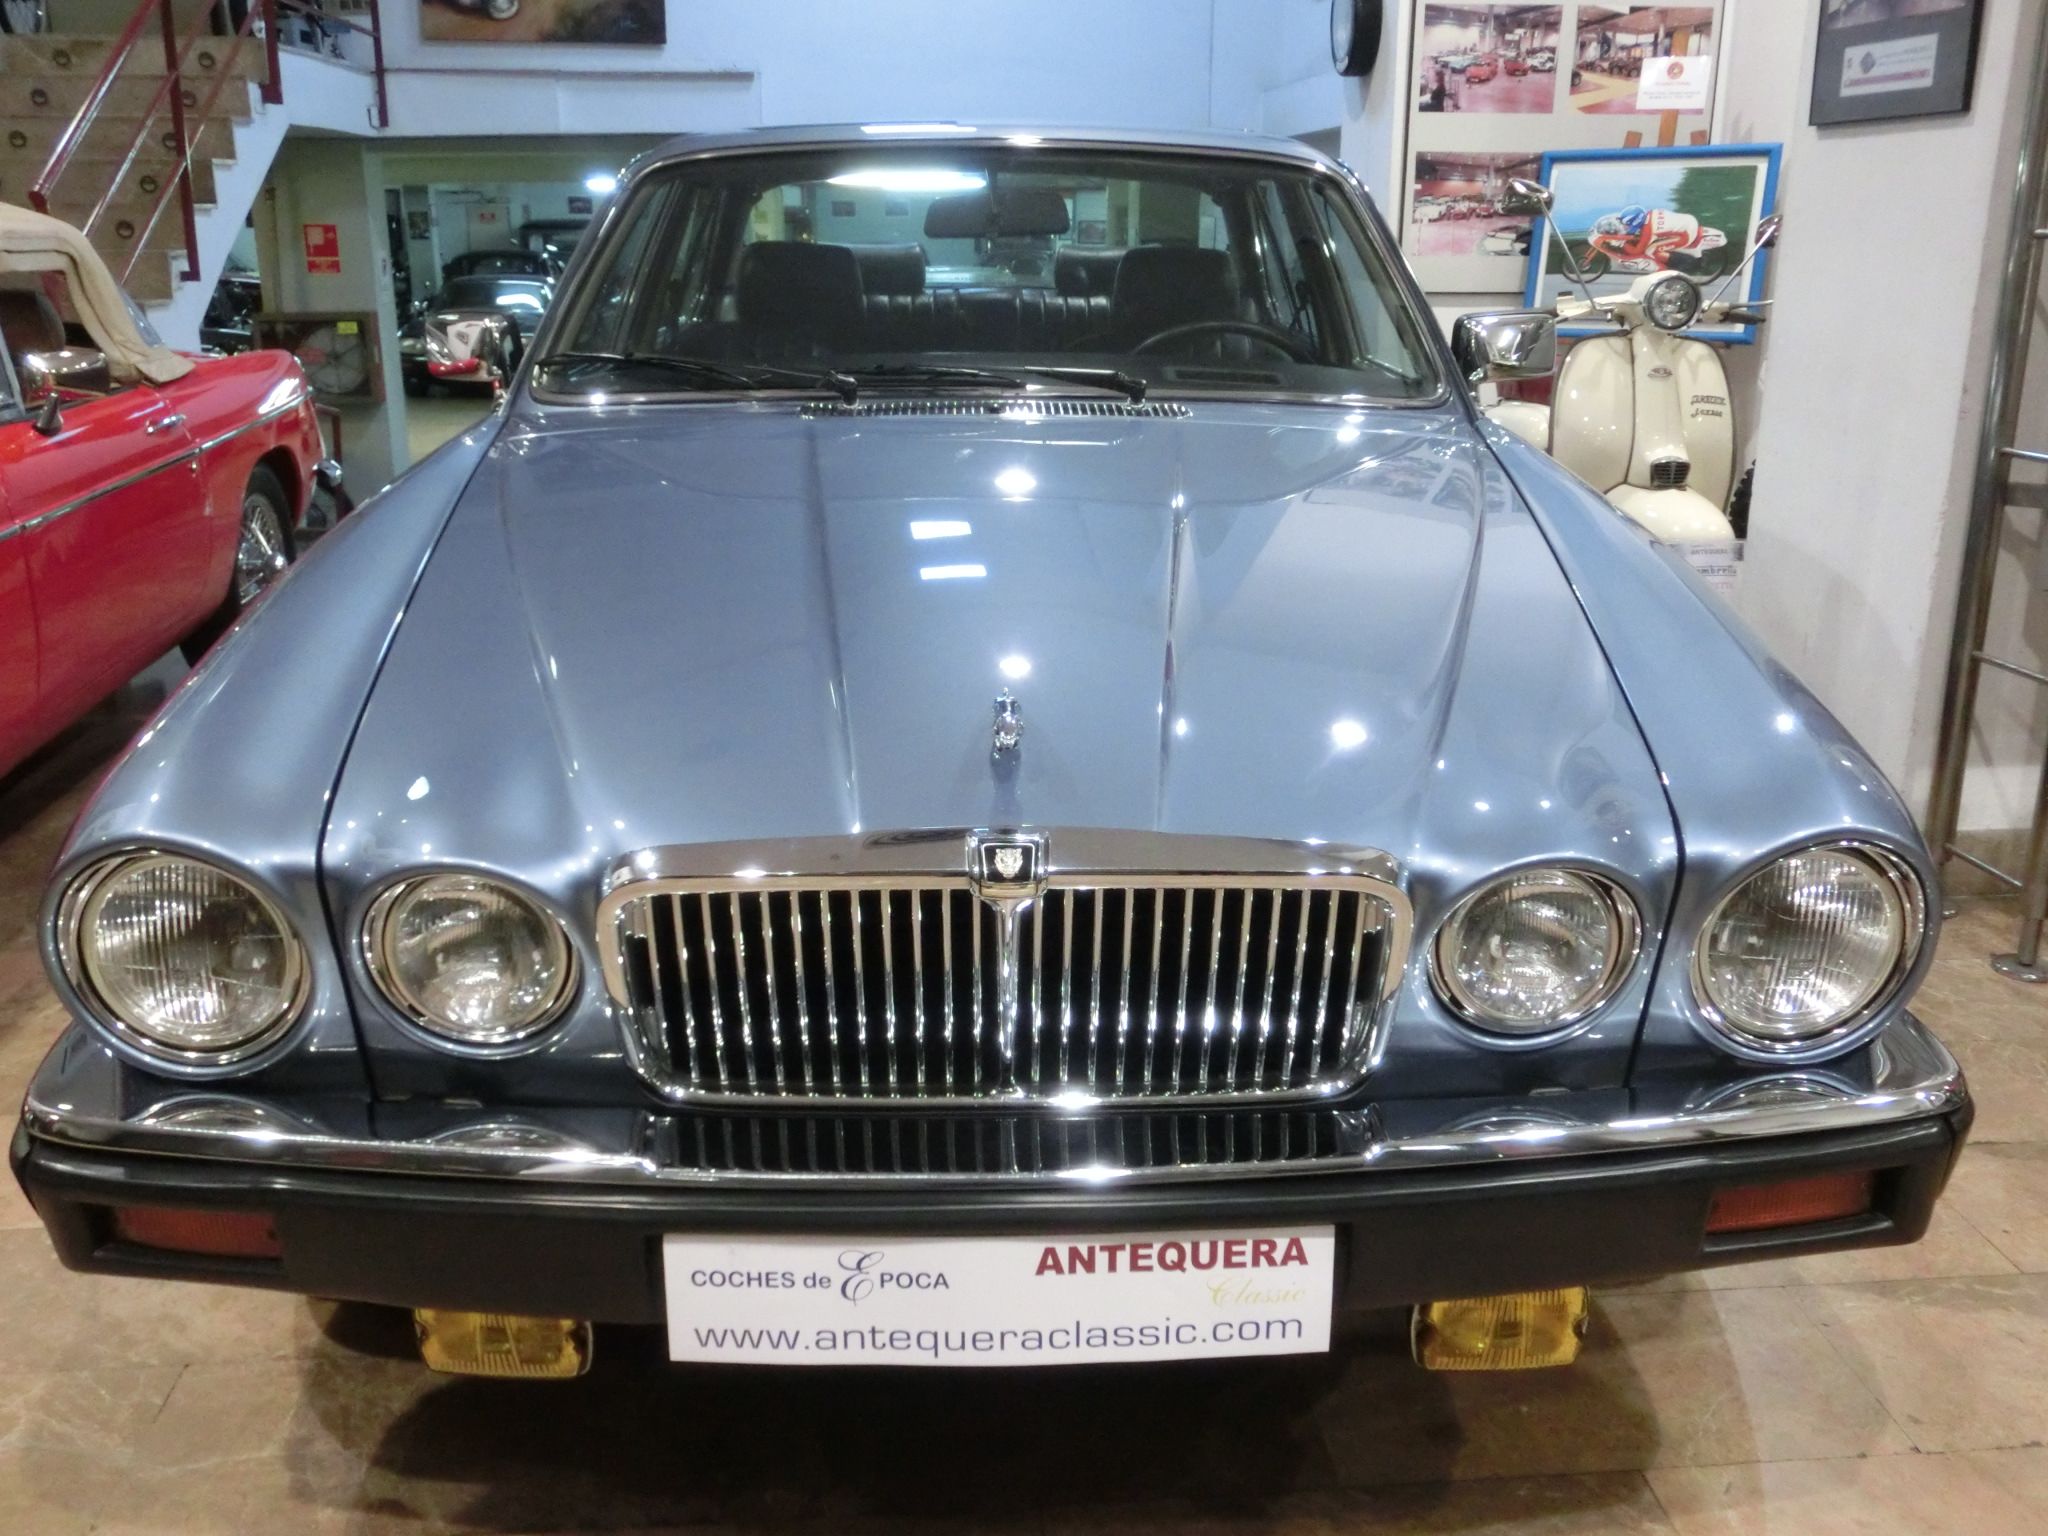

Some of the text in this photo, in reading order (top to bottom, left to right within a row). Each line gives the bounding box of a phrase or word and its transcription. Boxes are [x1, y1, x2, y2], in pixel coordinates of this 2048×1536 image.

[1035, 1236, 1309, 1276] ANTEQUERA
[691, 1270, 796, 1288] COCHES
[803, 1272, 832, 1288] de
[1207, 1276, 1307, 1307] Classic
[694, 1316, 1304, 1358] www.antequeraclassic.com
